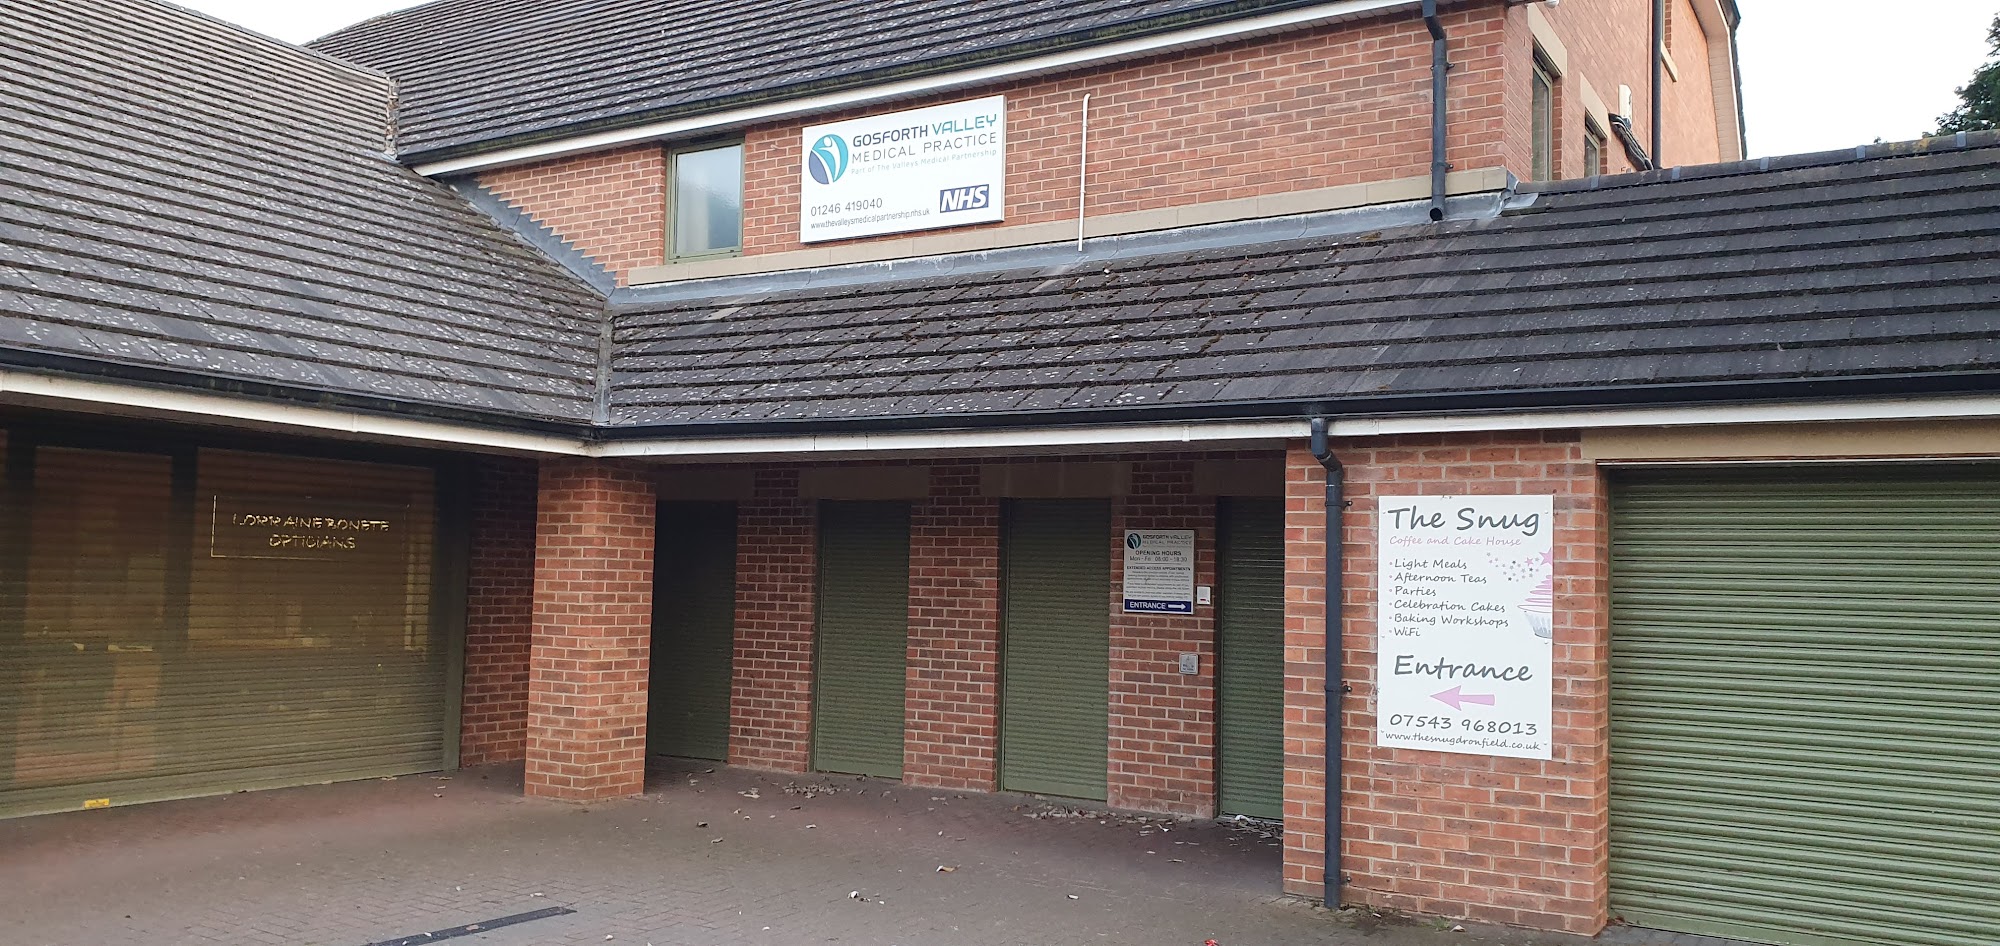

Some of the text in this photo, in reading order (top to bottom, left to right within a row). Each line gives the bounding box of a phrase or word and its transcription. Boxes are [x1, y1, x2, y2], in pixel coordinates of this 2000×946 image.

[853, 114, 997, 147] GOSFORTH VALLEY
[852, 132, 996, 164] MEDICAL PRACTICE
[877, 163, 889, 171] The
[892, 159, 918, 169] Valleys
[921, 155, 949, 165] Medical
[951, 149, 997, 160] Partnership
[811, 198, 882, 216] 01246 419040
[941, 186, 988, 212] NHS
[1388, 506, 1540, 536] The Snug
[1389, 536, 1521, 547] Coffee and Cake House
[1394, 559, 1467, 570] Light Meals
[1394, 572, 1487, 584] Afternoon Teas
[1395, 586, 1436, 596] Parties
[1394, 600, 1505, 613] Celebration Cakes
[1394, 613, 1509, 627] Baking Workshops
[1394, 627, 1421, 637] WiFi
[1394, 655, 1533, 682] Entrance
[1390, 714, 1537, 735] 07543 968013
[1385, 732, 1540, 750] www.thesnugdronfield.co.uk
